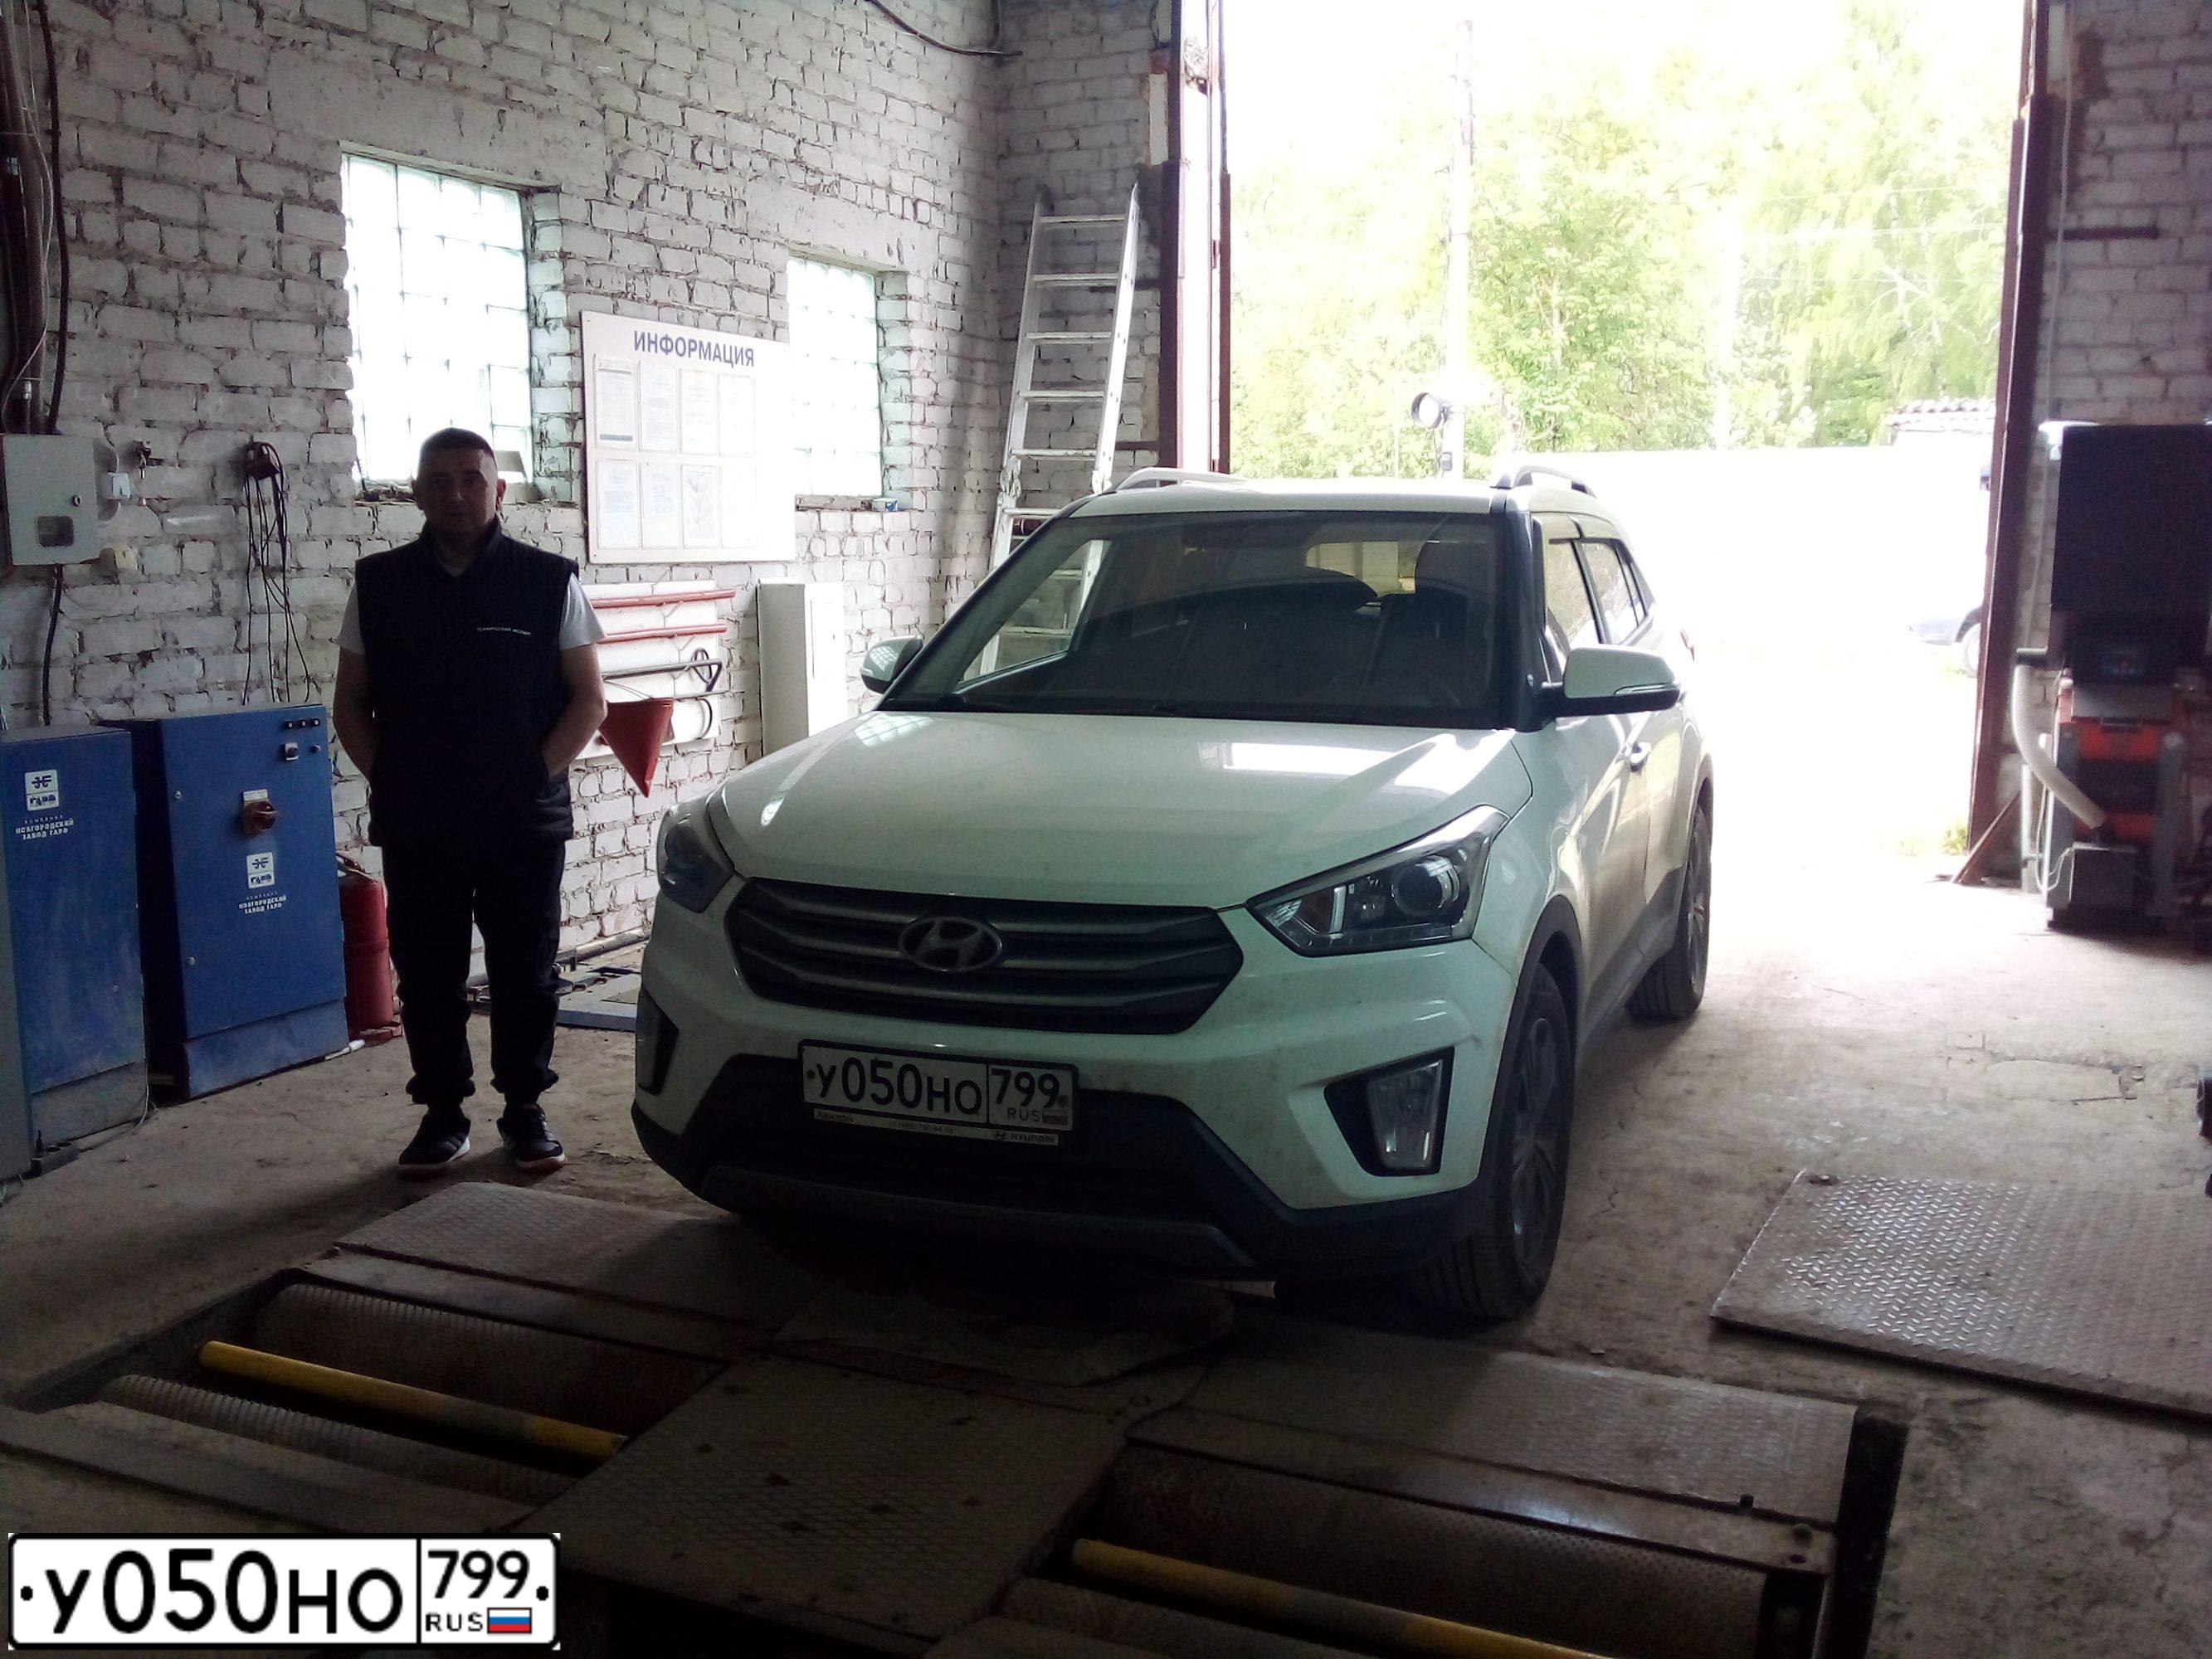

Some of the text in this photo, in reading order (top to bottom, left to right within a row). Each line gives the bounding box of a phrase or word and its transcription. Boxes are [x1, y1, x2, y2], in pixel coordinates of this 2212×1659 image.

[633, 330, 754, 368] ИНФОРМАЦИЯ
[816, 1057, 1060, 1115] У050НО 799
[1007, 1107, 1039, 1122] RUS
